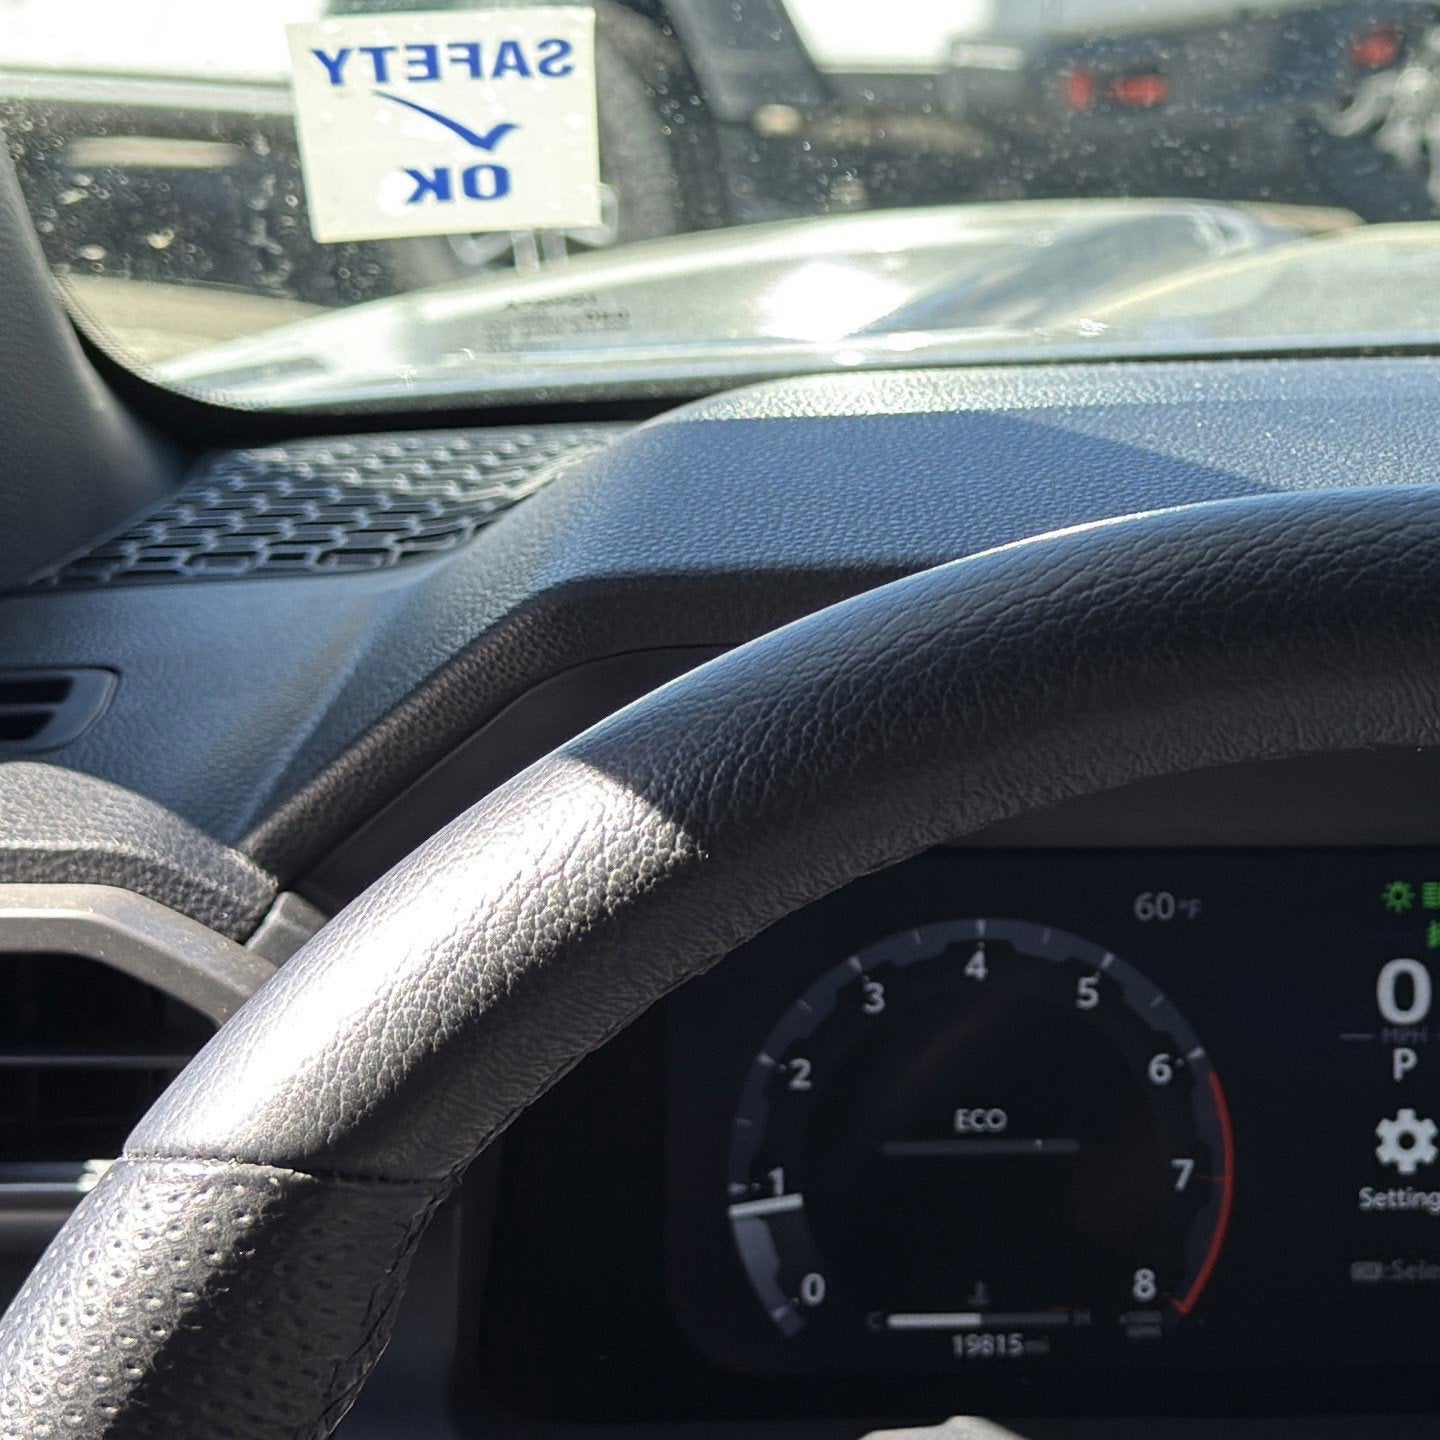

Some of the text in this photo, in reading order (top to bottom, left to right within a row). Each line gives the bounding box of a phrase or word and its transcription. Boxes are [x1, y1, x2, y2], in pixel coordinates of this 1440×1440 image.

[964, 949, 988, 981] 4
[864, 982, 886, 1014] 3
[1077, 977, 1099, 1010] 5
[1376, 957, 1432, 1026] 0
[789, 1058, 812, 1089] 2
[1149, 1054, 1173, 1085] 6
[1393, 1047, 1418, 1082] P
[953, 1108, 1007, 1133] ECO
[767, 1167, 784, 1195] 1
[1171, 1158, 1195, 1190] 7
[802, 1273, 825, 1305] 0
[1133, 1268, 1157, 1301] 8
[952, 1333, 1024, 1358] 19815
